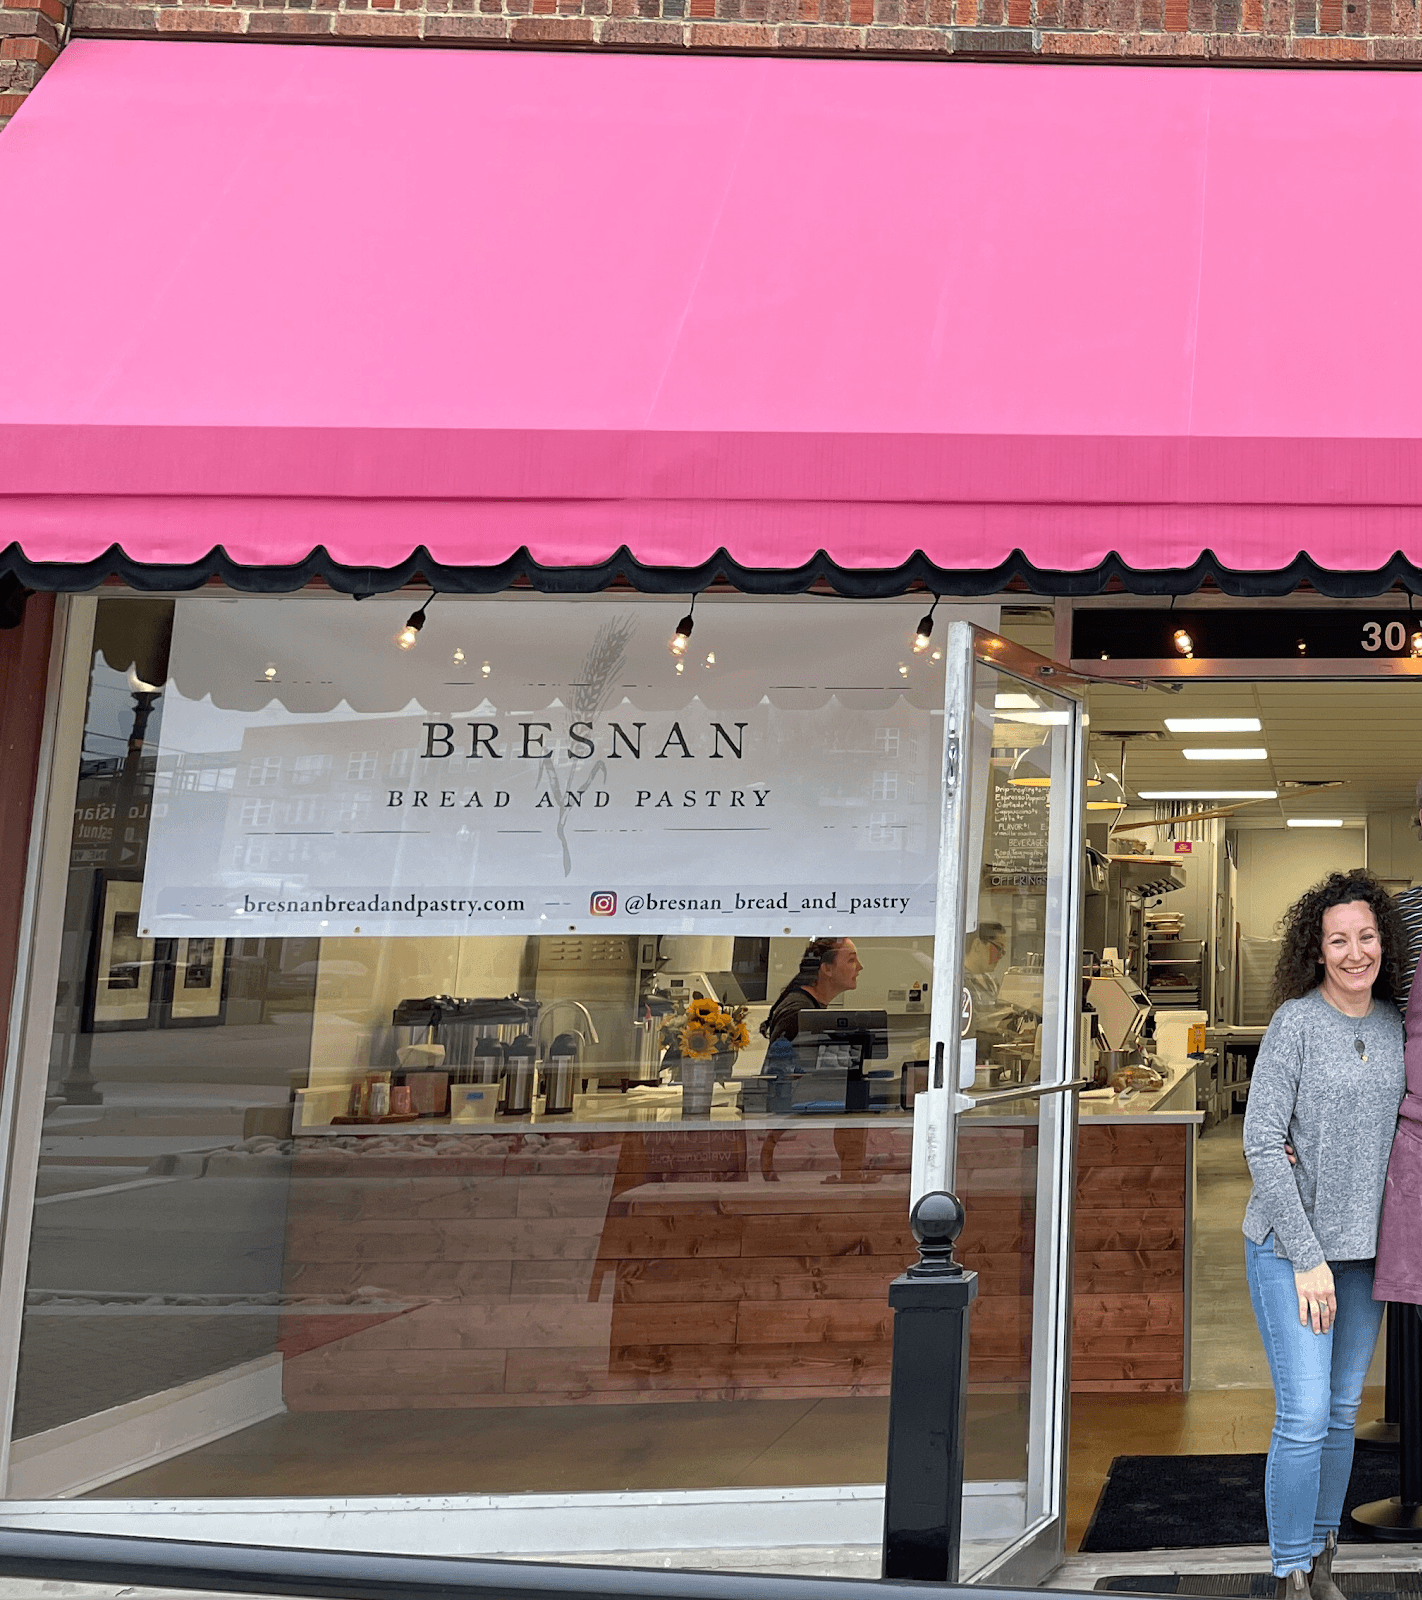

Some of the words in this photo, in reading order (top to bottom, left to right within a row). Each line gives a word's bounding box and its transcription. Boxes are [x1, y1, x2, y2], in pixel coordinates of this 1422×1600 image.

[420, 721, 749, 760] BRESNAN
[387, 790, 510, 808] BREAD
[535, 790, 610, 808] AND
[634, 790, 771, 808] PASTRY
[1008, 838, 1049, 848] BEVERAGES
[991, 875, 1047, 887] OFFERINGS
[243, 894, 525, 917] bresnanbreadandpastry.com
[624, 892, 911, 915] @bresnan_bread_and_pastry
